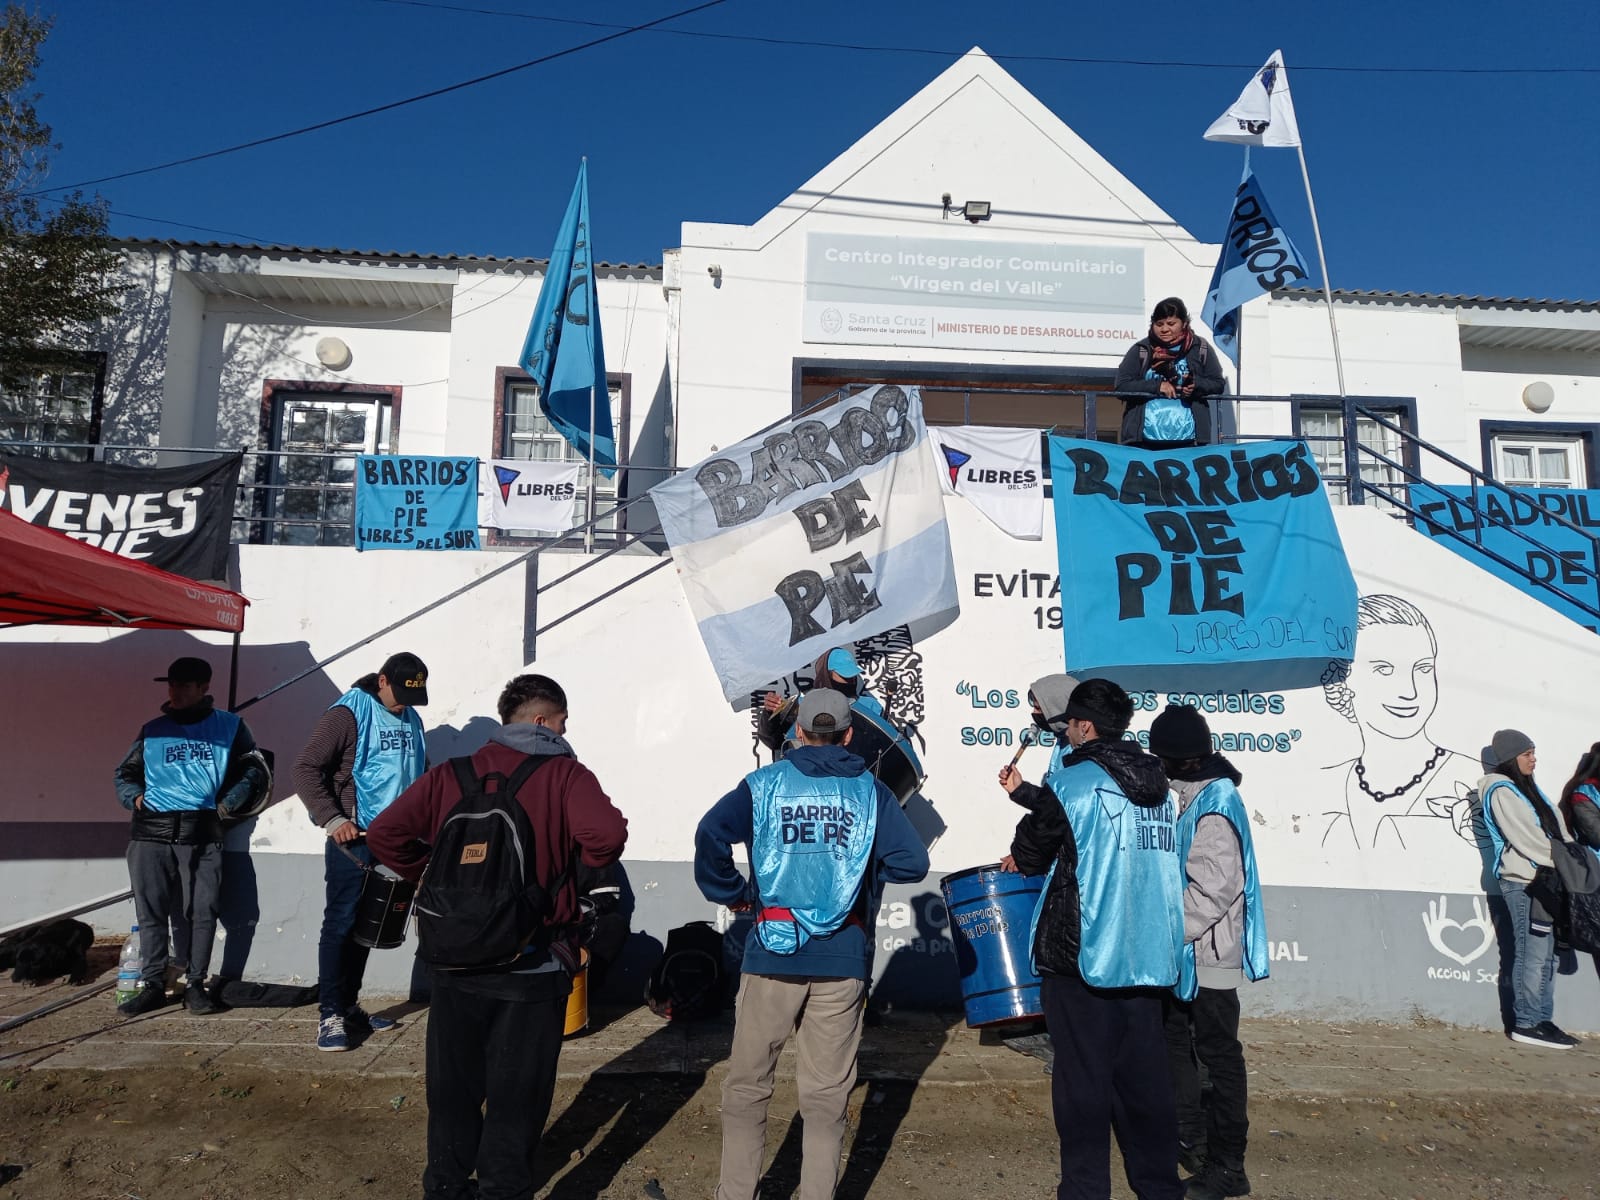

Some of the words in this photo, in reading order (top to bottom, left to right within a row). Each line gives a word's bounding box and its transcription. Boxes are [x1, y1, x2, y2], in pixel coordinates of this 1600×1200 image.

[824, 248, 893, 265] Centro
[898, 250, 1004, 270] Integrador
[1008, 256, 1128, 276] Comunitario
[891, 274, 964, 295] “Virgen
[970, 277, 1000, 293] del
[1004, 280, 1063, 297] Valle”
[848, 313, 890, 326] Santa
[894, 315, 926, 328] Cruz
[848, 325, 878, 334] Gobierno
[896, 328, 927, 336] provincia
[936, 322, 1001, 336] MINISTERIO
[1002, 325, 1019, 337] DE
[1020, 326, 1095, 340] DESARROLLO
[1096, 329, 1138, 341] SOCIAL
[695, 385, 916, 528] BARRIOS
[363, 458, 469, 486] BARRIOS
[967, 468, 1038, 485] LIBRES
[405, 489, 425, 505] DE
[516, 481, 575, 497] LIBRES
[1007, 482, 1021, 491] DEL
[1021, 482, 1039, 490] SUR
[0, 484, 204, 538] VENES
[394, 507, 428, 527] PIE
[792, 478, 882, 553] DE
[358, 527, 414, 544] LIBRES
[415, 536, 443, 550] DEL
[443, 529, 477, 549] SUR
[1143, 510, 1247, 555] DE
[1525, 550, 1589, 586] DE
[1171, 620, 1260, 656] LIBRES
[1260, 616, 1317, 649] DEL
[1323, 617, 1354, 653] SUR
[1166, 689, 1286, 715] sociales
[380, 739, 401, 751] DE
[961, 726, 1013, 747] son
[1211, 729, 1302, 753] manos”
[166, 750, 187, 764] DE
[190, 750, 213, 761] PIE
[781, 804, 856, 828] BARRIOS
[782, 822, 817, 846] DE
